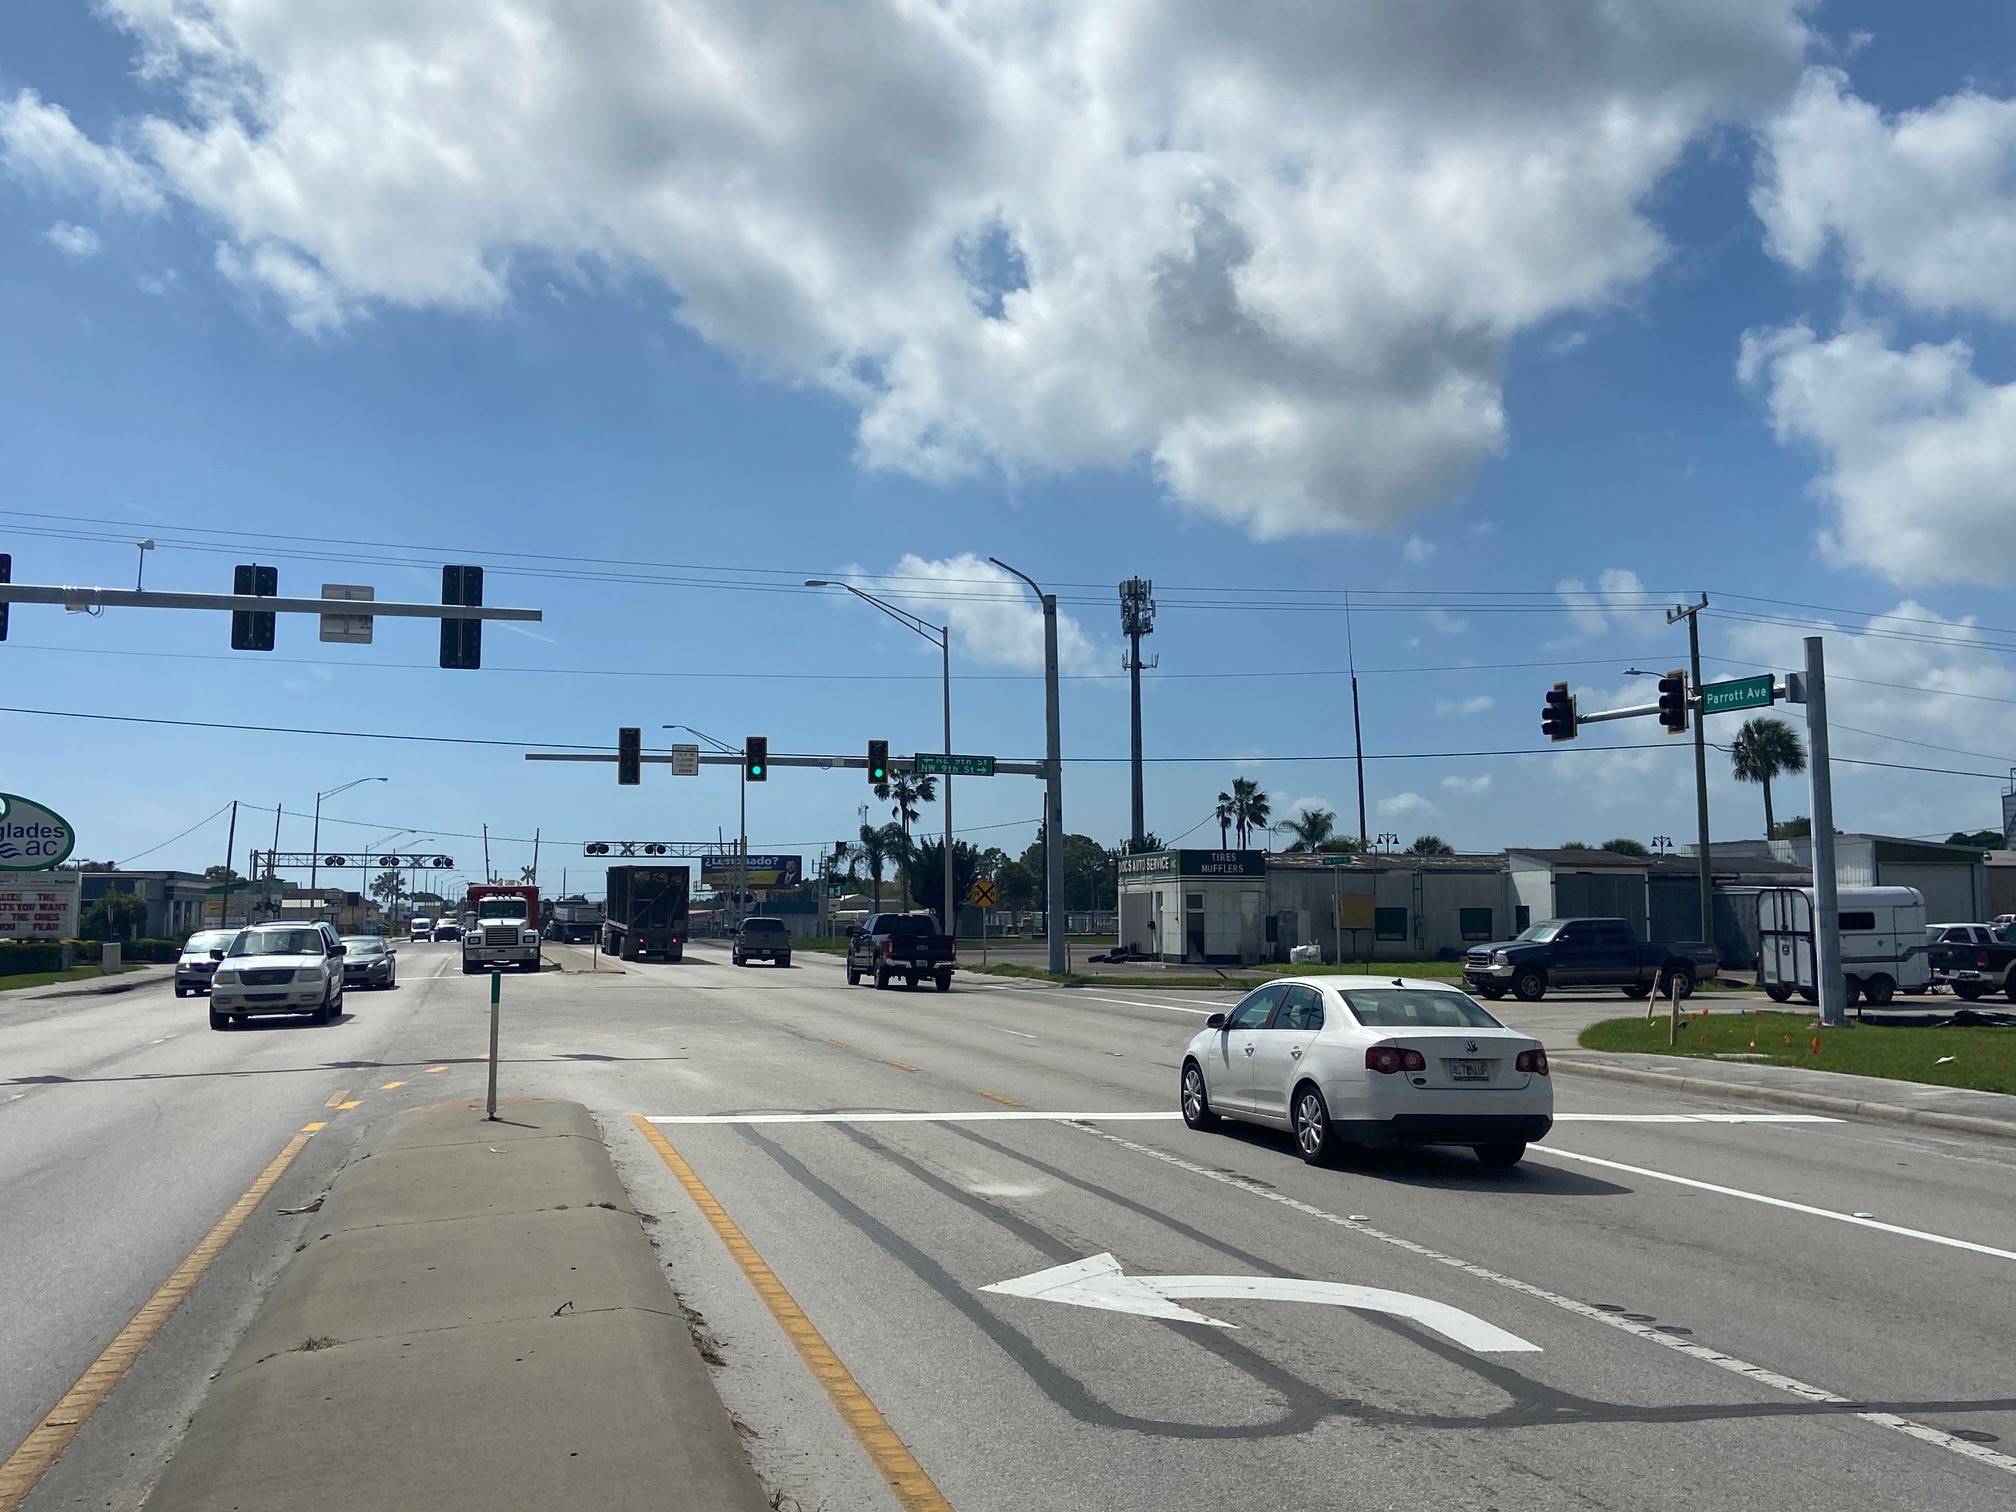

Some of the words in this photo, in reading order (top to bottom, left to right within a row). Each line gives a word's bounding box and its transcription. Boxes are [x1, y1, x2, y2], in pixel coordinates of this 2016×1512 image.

[1707, 689, 1744, 704] Parrott
[1747, 687, 1767, 699] Ave
[921, 764, 936, 772] NW
[941, 765, 959, 773] 9th
[25, 840, 58, 856] ac
[1211, 852, 1237, 862] TIRES
[1147, 856, 1170, 870] SERVICE
[1201, 864, 1244, 873] MUFFLERS
[37, 893, 57, 901] THE
[17, 903, 35, 911] YOU
[39, 903, 68, 911] WANT
[11, 913, 29, 921] THE
[34, 913, 60, 921] ONES
[33, 923, 59, 931] FEAR
